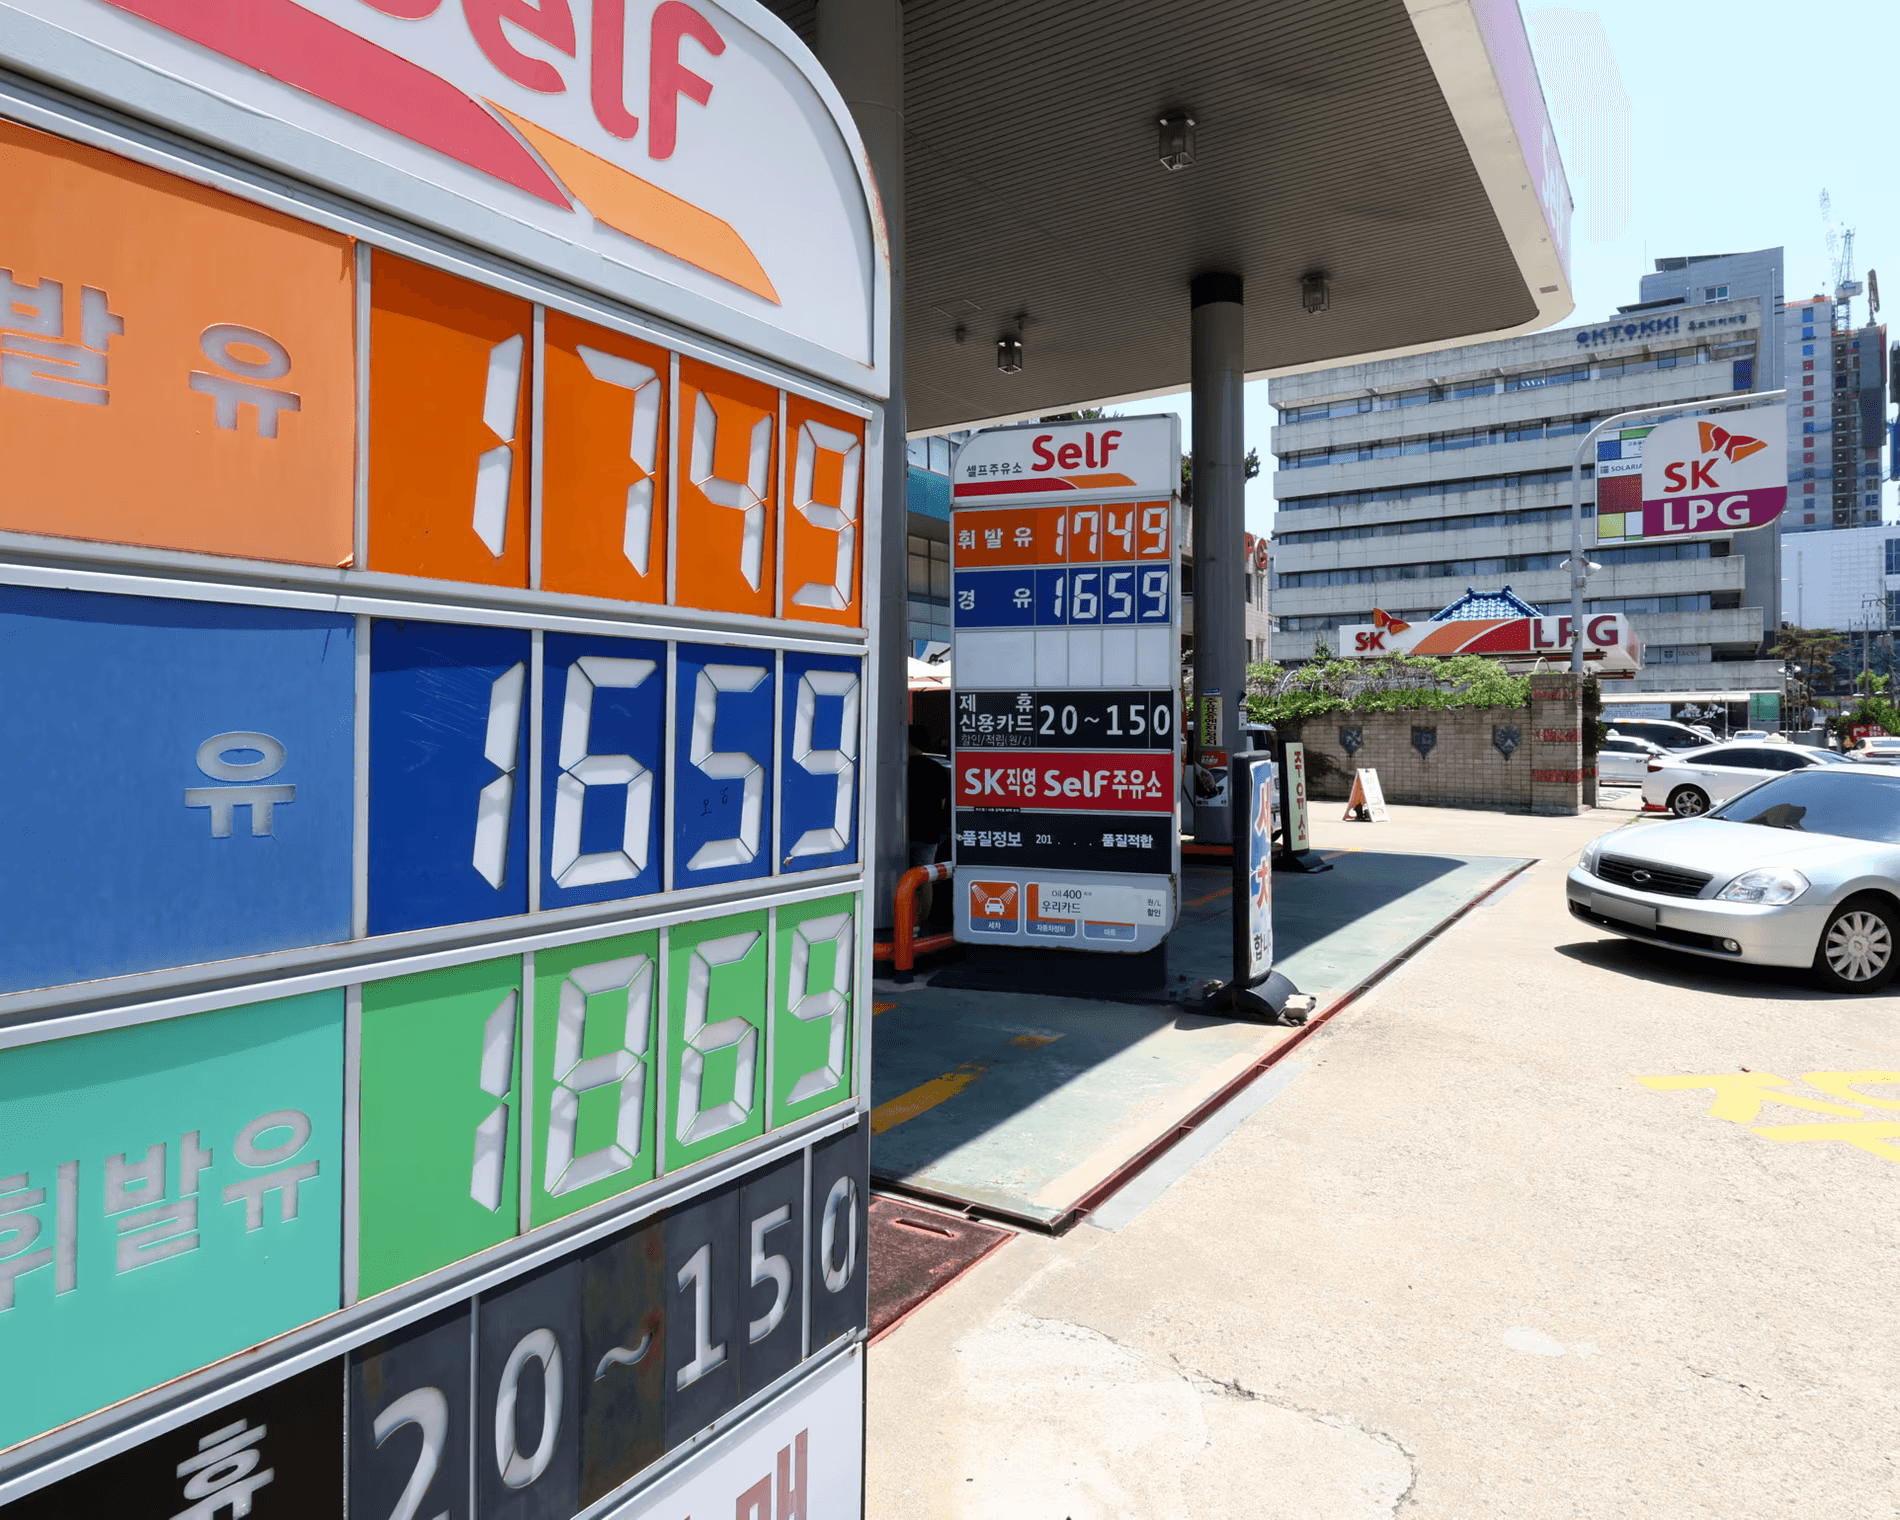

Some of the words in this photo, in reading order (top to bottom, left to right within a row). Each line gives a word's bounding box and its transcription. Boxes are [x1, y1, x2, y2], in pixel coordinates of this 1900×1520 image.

[359, 0, 726, 161] elf
[1031, 430, 1122, 471] Self
[472, 333, 861, 611] 1749
[966, 462, 1023, 477] 셀프주유소
[1663, 458, 1720, 493] SK
[1663, 495, 1750, 531] LPG
[1055, 507, 1168, 556] 1749
[1054, 571, 1168, 619] 1659
[1355, 631, 1386, 651] SK
[960, 713, 1034, 733] 신용카드
[184, 731, 297, 839] 유
[472, 656, 860, 892] 1659
[964, 768, 1037, 797] SK직영
[962, 830, 1023, 848] 품질정보
[1101, 833, 1153, 849] 품질적합
[1042, 901, 1082, 914] 우리카드
[1063, 889, 1083, 900] 400
[1147, 908, 1161, 918] 할인
[470, 911, 853, 1214] 1869
